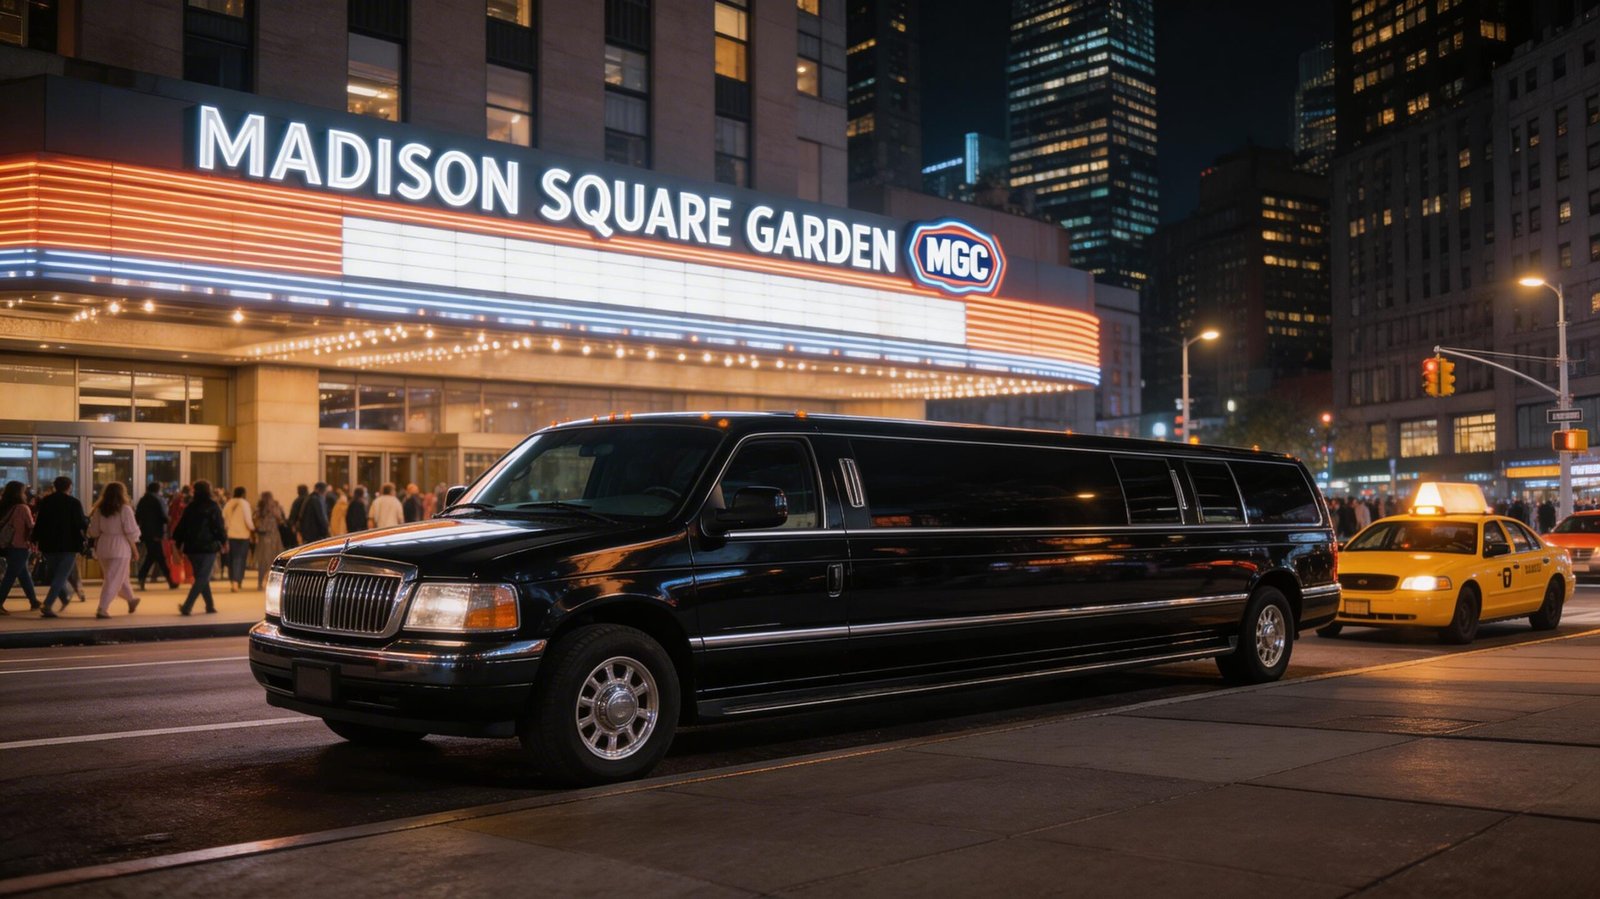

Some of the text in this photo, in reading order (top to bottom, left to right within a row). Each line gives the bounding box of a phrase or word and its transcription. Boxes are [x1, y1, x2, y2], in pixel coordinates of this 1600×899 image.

[199, 105, 896, 273] MADISON SQUARE GARDEN
[926, 237, 989, 281] MGC
